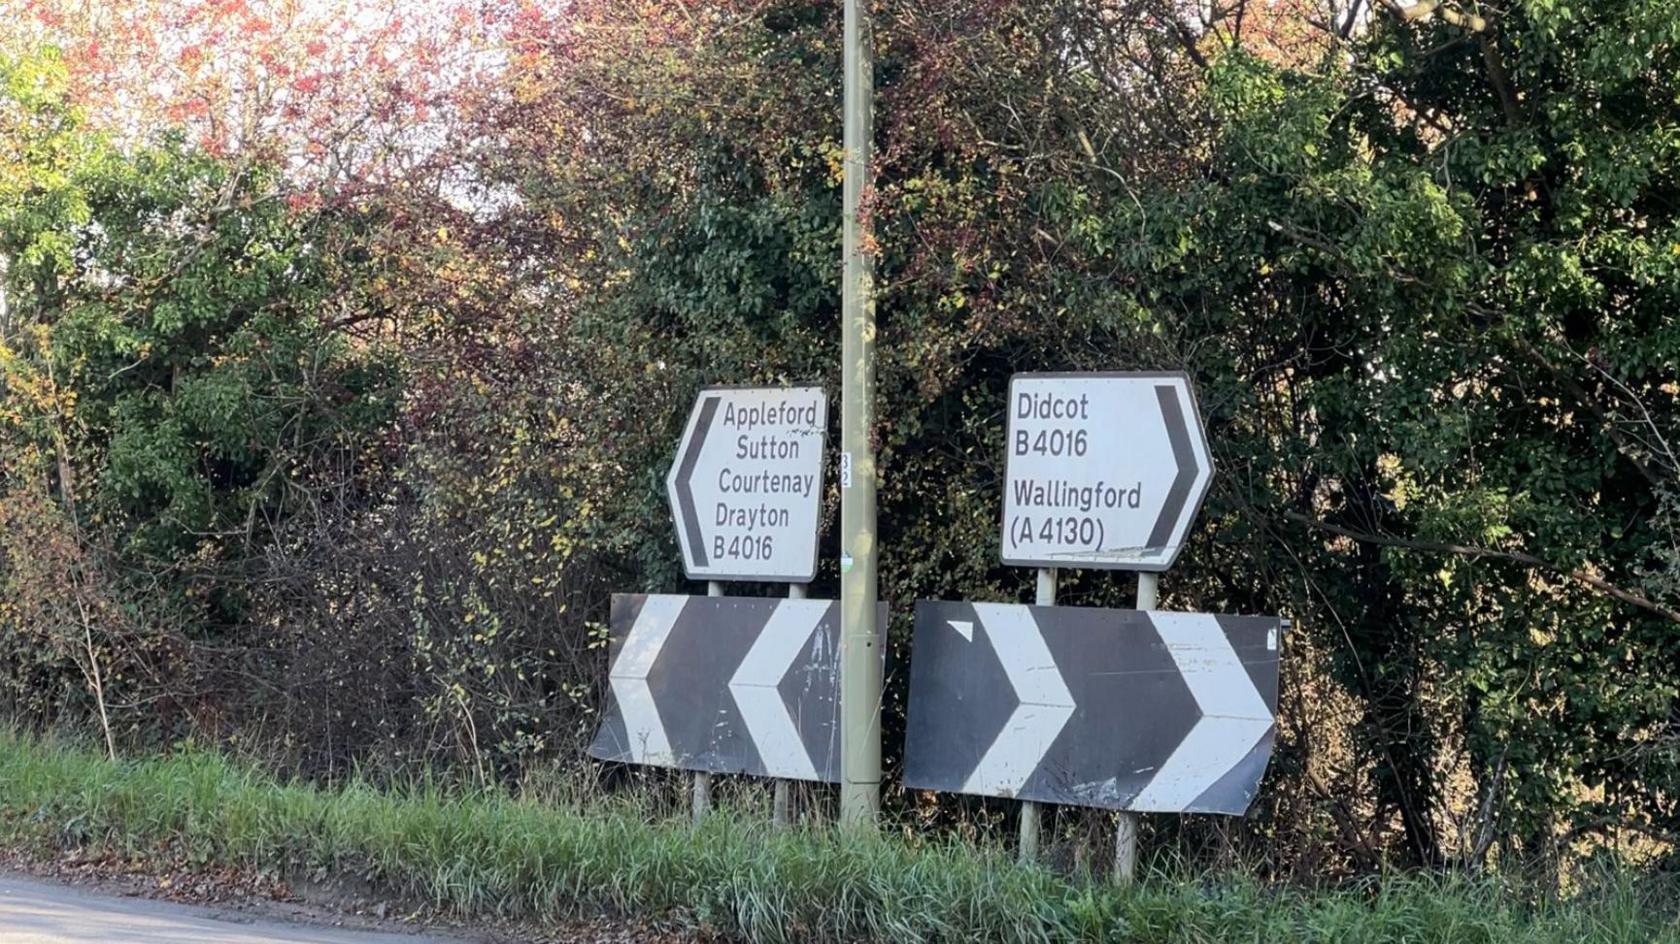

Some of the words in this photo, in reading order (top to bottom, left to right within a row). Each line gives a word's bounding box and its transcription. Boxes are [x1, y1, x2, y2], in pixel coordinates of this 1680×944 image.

[723, 400, 817, 431] Appleford
[1017, 392, 1089, 420] Didcot
[736, 434, 799, 460] Sutton
[718, 467, 814, 498] Courtenay
[1014, 479, 1142, 513] Wallingford
[715, 502, 789, 532] Drayton
